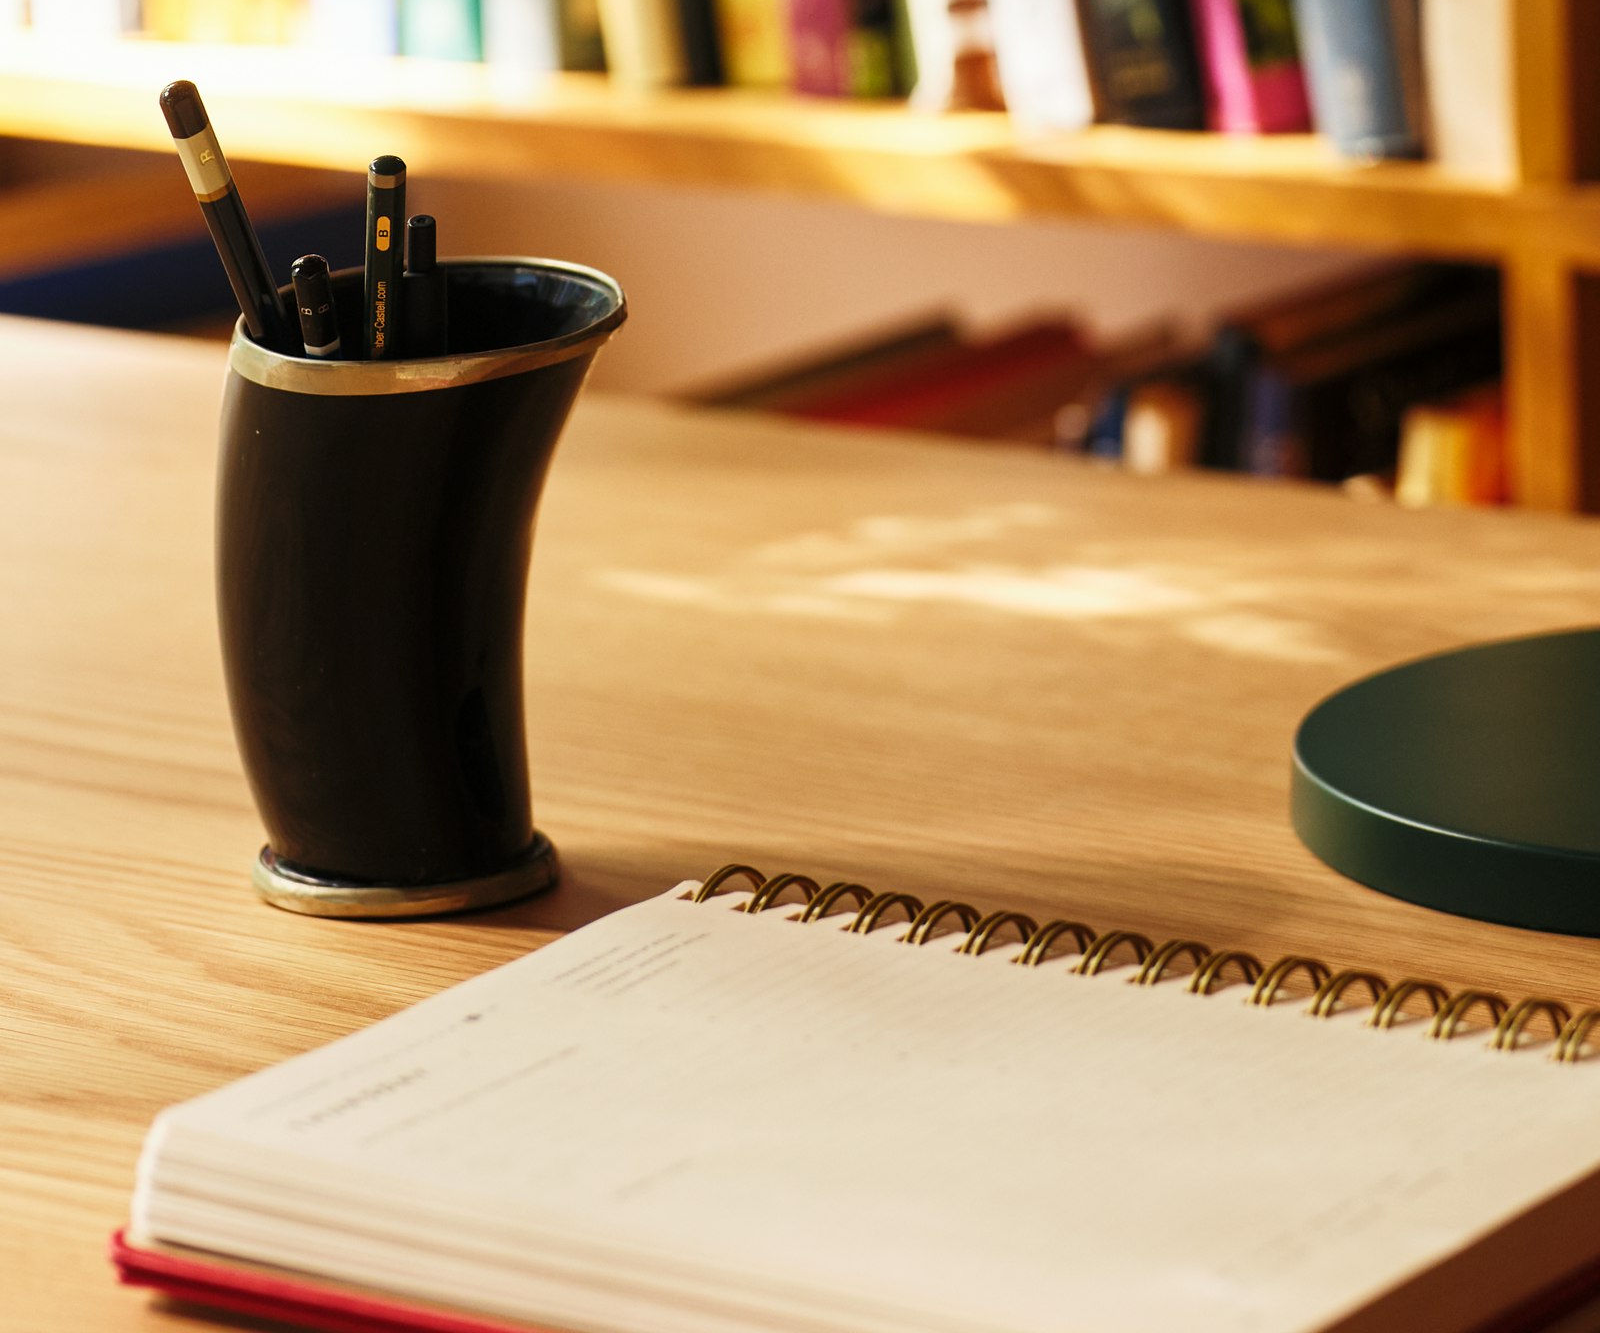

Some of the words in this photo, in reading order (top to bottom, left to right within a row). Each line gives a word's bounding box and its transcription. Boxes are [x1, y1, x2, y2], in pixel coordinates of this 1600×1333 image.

[378, 229, 389, 238] B
[301, 307, 313, 316] B
[374, 281, 387, 349] aber-Castell.com
